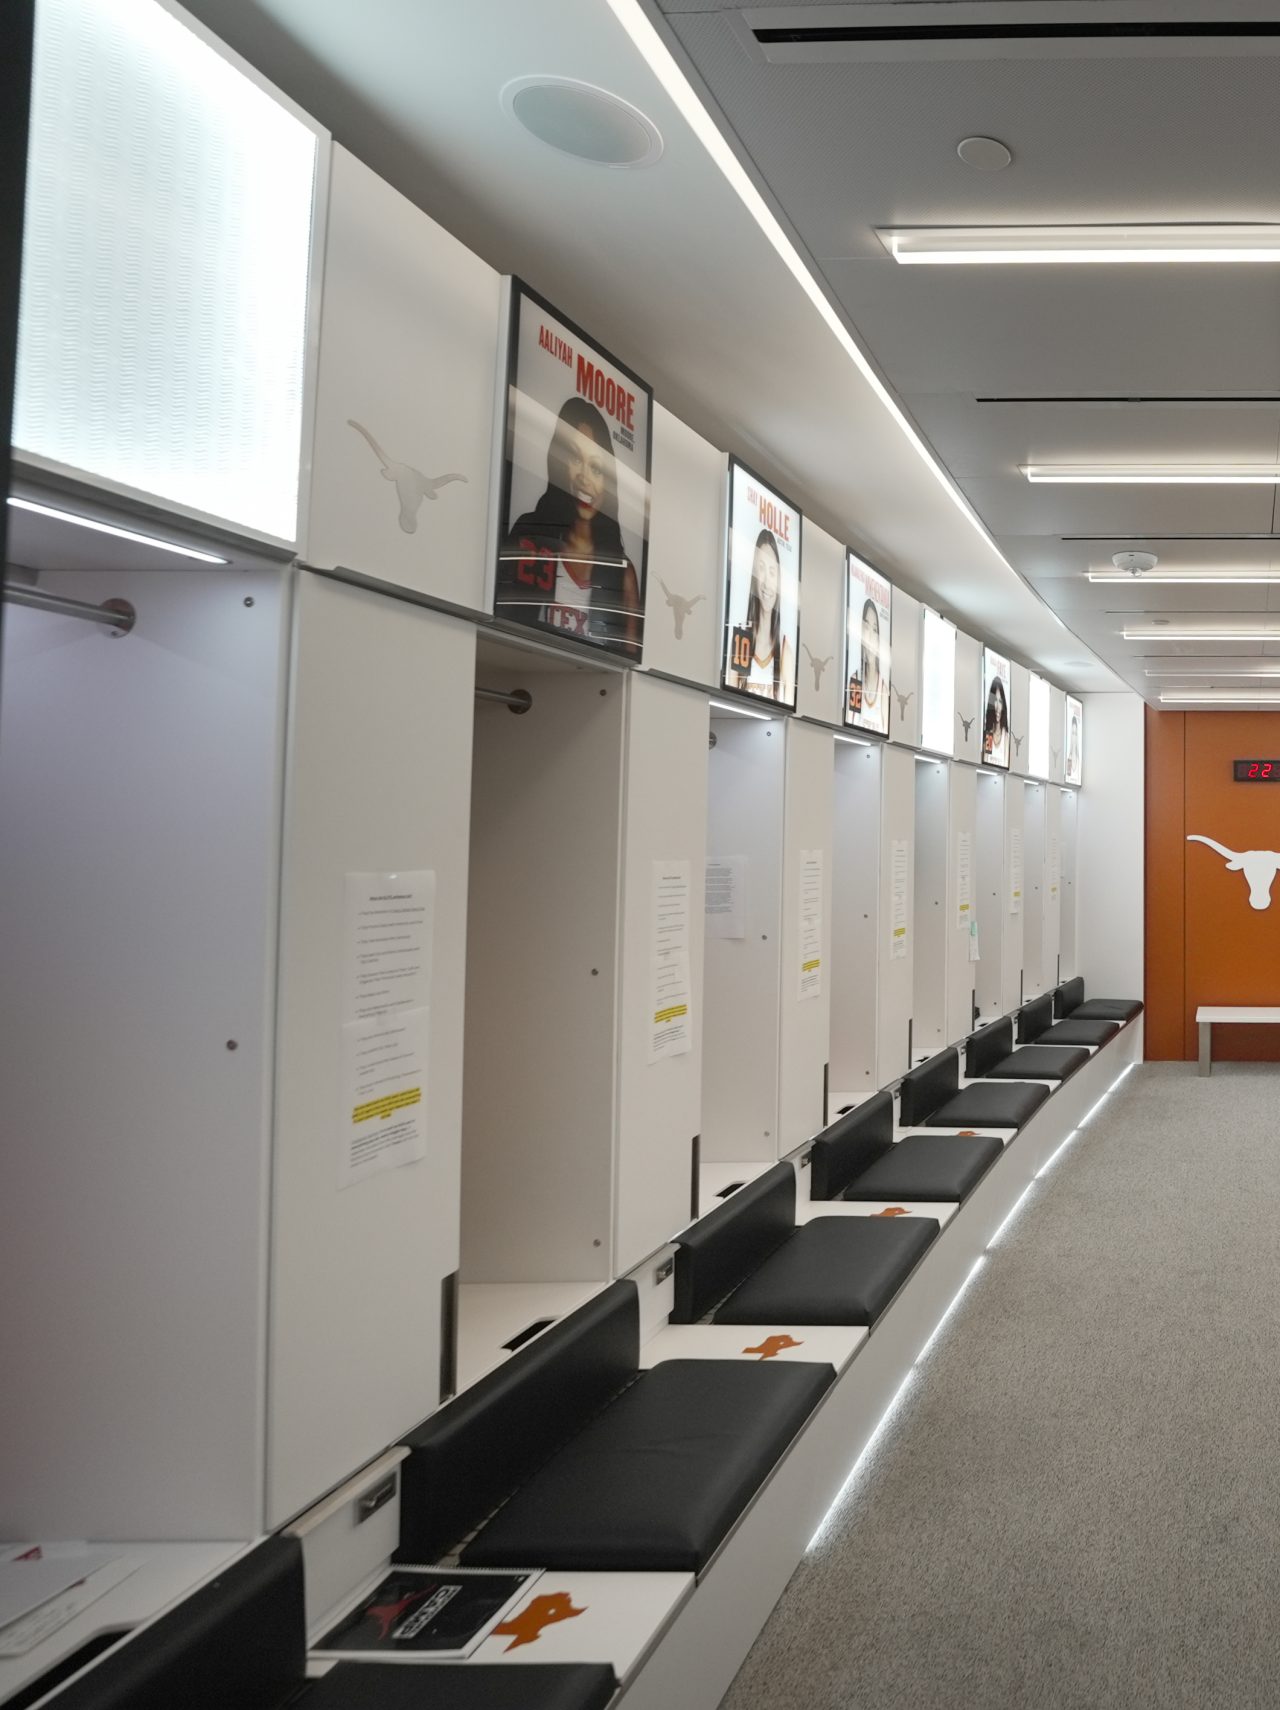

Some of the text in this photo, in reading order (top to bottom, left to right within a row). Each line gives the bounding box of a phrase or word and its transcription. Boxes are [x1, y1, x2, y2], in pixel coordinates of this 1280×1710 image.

[538, 324, 635, 431] AALIYAH MOORE
[759, 495, 790, 542] HOLLE
[518, 537, 556, 592] 23
[733, 634, 750, 669] 10
[1247, 763, 1272, 778] 22
